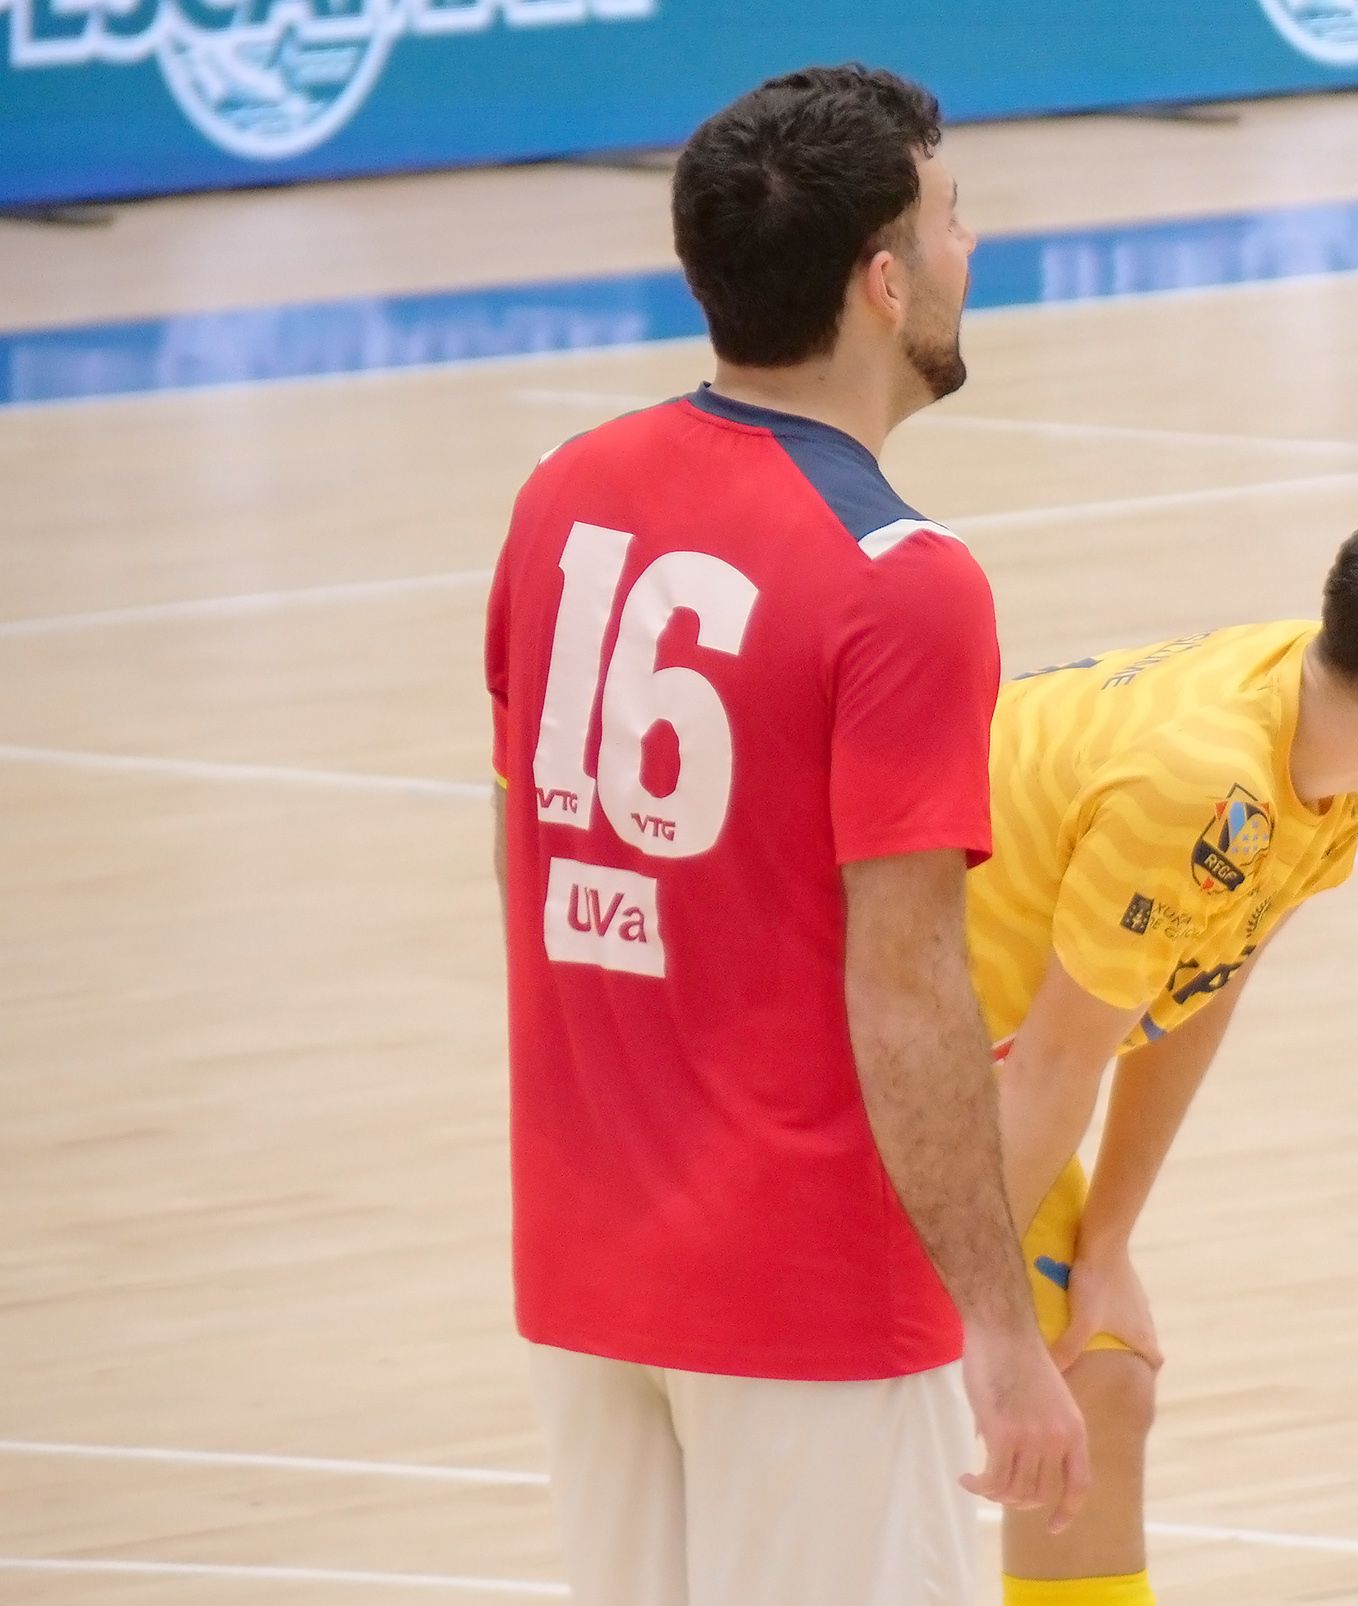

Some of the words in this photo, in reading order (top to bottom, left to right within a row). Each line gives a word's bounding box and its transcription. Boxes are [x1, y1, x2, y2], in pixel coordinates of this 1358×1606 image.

[534, 521, 759, 858] 16
[631, 812, 676, 841] VTG
[567, 883, 647, 943] UVa
